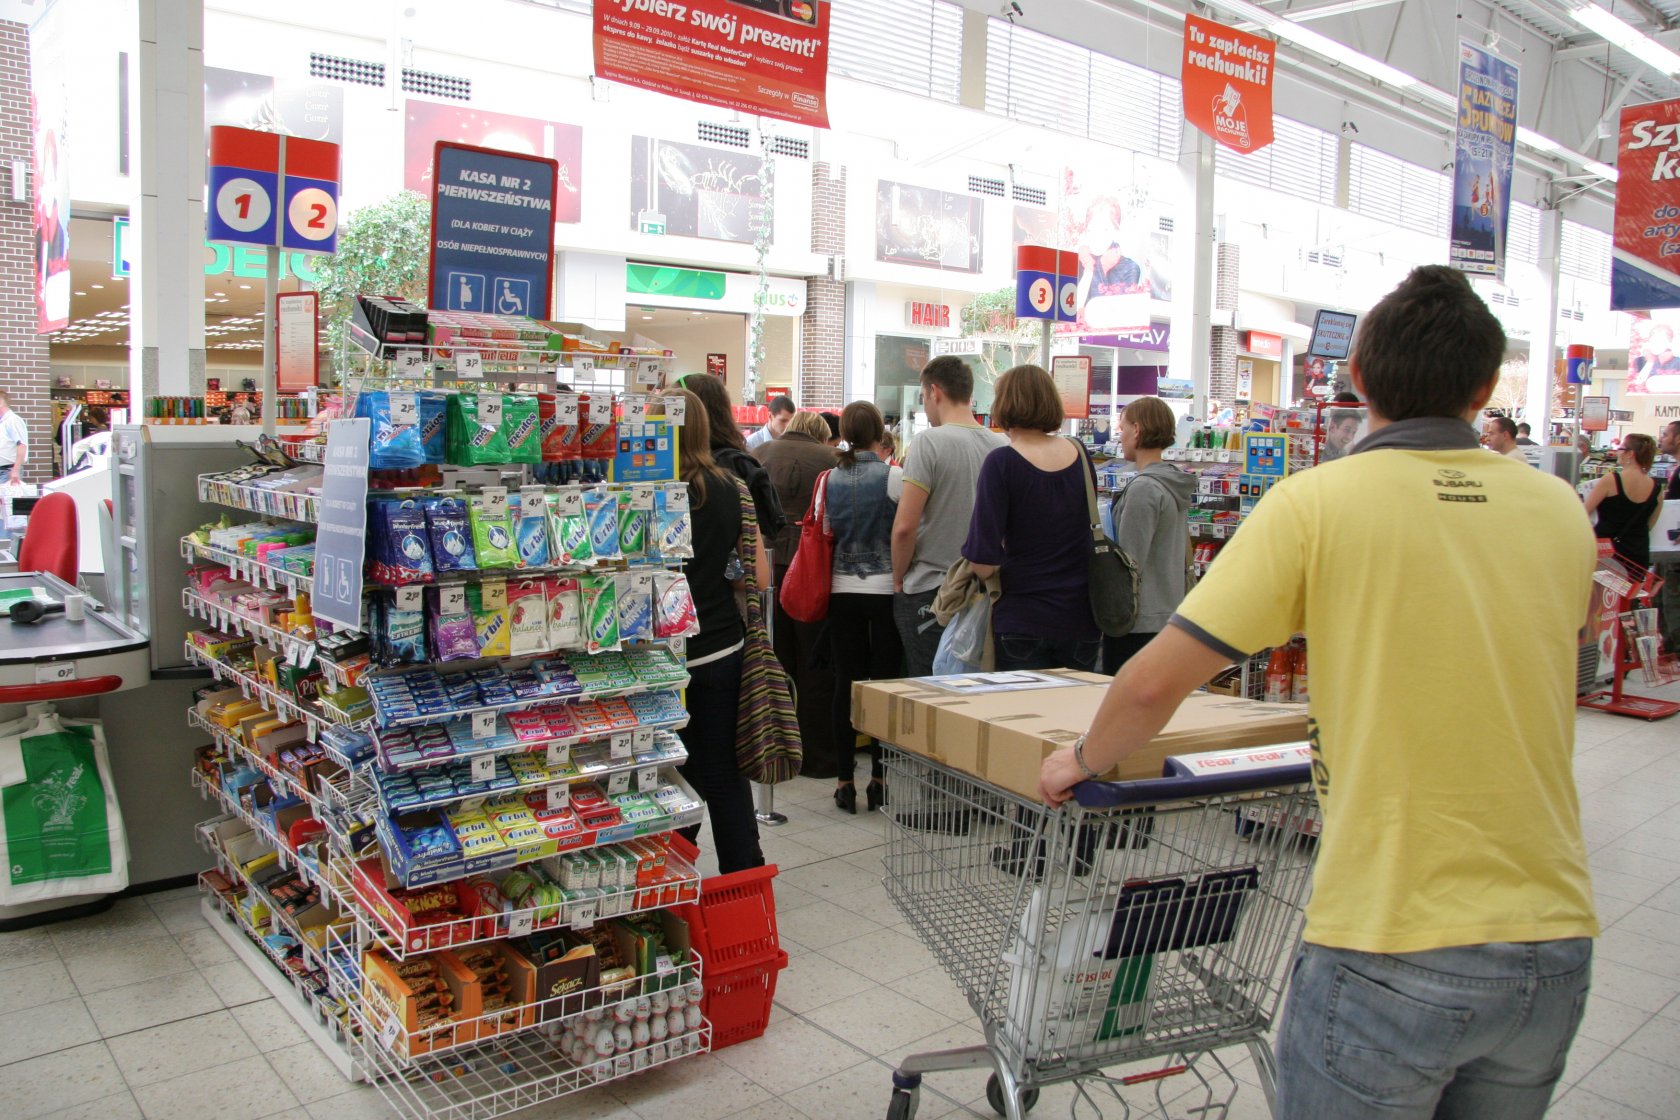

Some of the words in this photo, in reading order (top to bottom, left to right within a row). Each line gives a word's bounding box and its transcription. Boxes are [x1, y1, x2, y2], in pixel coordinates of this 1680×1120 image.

[608, 0, 686, 22] ybierz
[691, 10, 738, 41] swój
[611, 16, 628, 27] dniach
[603, 25, 626, 37] ekspres
[627, 31, 636, 39] do
[1189, 25, 1205, 44] Tu
[1209, 37, 1270, 65] zapłacisz
[1188, 50, 1267, 86] rachunki!
[757, 85, 784, 100] Szczegóły
[1216, 115, 1247, 132] MOJE
[1651, 152, 1680, 181] k
[460, 169, 496, 186] KASA
[501, 176, 520, 189] NR
[523, 180, 532, 191] 2
[234, 194, 252, 219] 1
[438, 184, 552, 211] PIERWSZEŃSTWA
[307, 203, 327, 229] 2
[1654, 205, 1680, 219] do
[451, 219, 471, 230] (DLA
[472, 223, 500, 233] KOBIET
[501, 226, 509, 234] W
[510, 226, 534, 238] CIĄŻY
[437, 240, 459, 250] OSÓB
[461, 243, 549, 262] NIEPEŁNOSPRAWNYCH)
[1037, 287, 1047, 304] 3
[1066, 291, 1075, 308] 4
[912, 301, 950, 327] HAIR
[1655, 406, 1680, 417] KANT
[1432, 479, 1483, 488] SUBARU
[1439, 493, 1487, 503] HOUSE
[566, 524, 586, 550] Orbit
[594, 515, 616, 545] Orbit
[623, 514, 643, 545] Orbit
[666, 519, 687, 545] Orbit
[523, 527, 545, 557] Orbit
[620, 599, 636, 618] Orbit
[595, 607, 615, 639] Orbit
[616, 792, 644, 804] Orbit
[654, 788, 680, 799] Orbit
[498, 811, 528, 823] Orbit
[628, 808, 658, 819] Orbit
[455, 821, 487, 835] Orbit
[508, 827, 538, 839] Orbit
[548, 823, 575, 834] Orbit
[465, 833, 496, 848] Orbit
[551, 977, 583, 998] Sękacz
